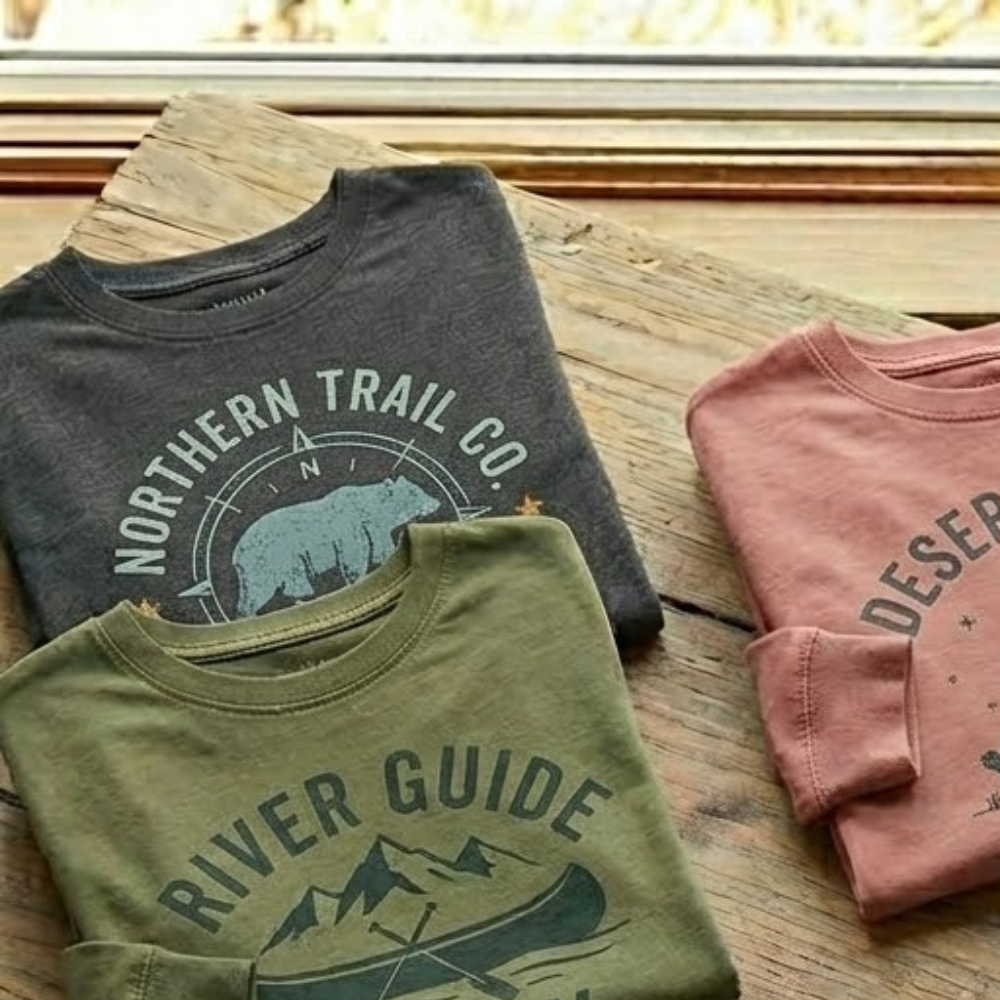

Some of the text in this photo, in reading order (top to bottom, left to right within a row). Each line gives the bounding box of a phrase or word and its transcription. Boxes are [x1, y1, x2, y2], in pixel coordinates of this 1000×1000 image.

[114, 367, 530, 576] NORTHERN TRAIL CO.
[300, 459, 320, 480] N
[157, 744, 614, 936] RIVER GUIDE
